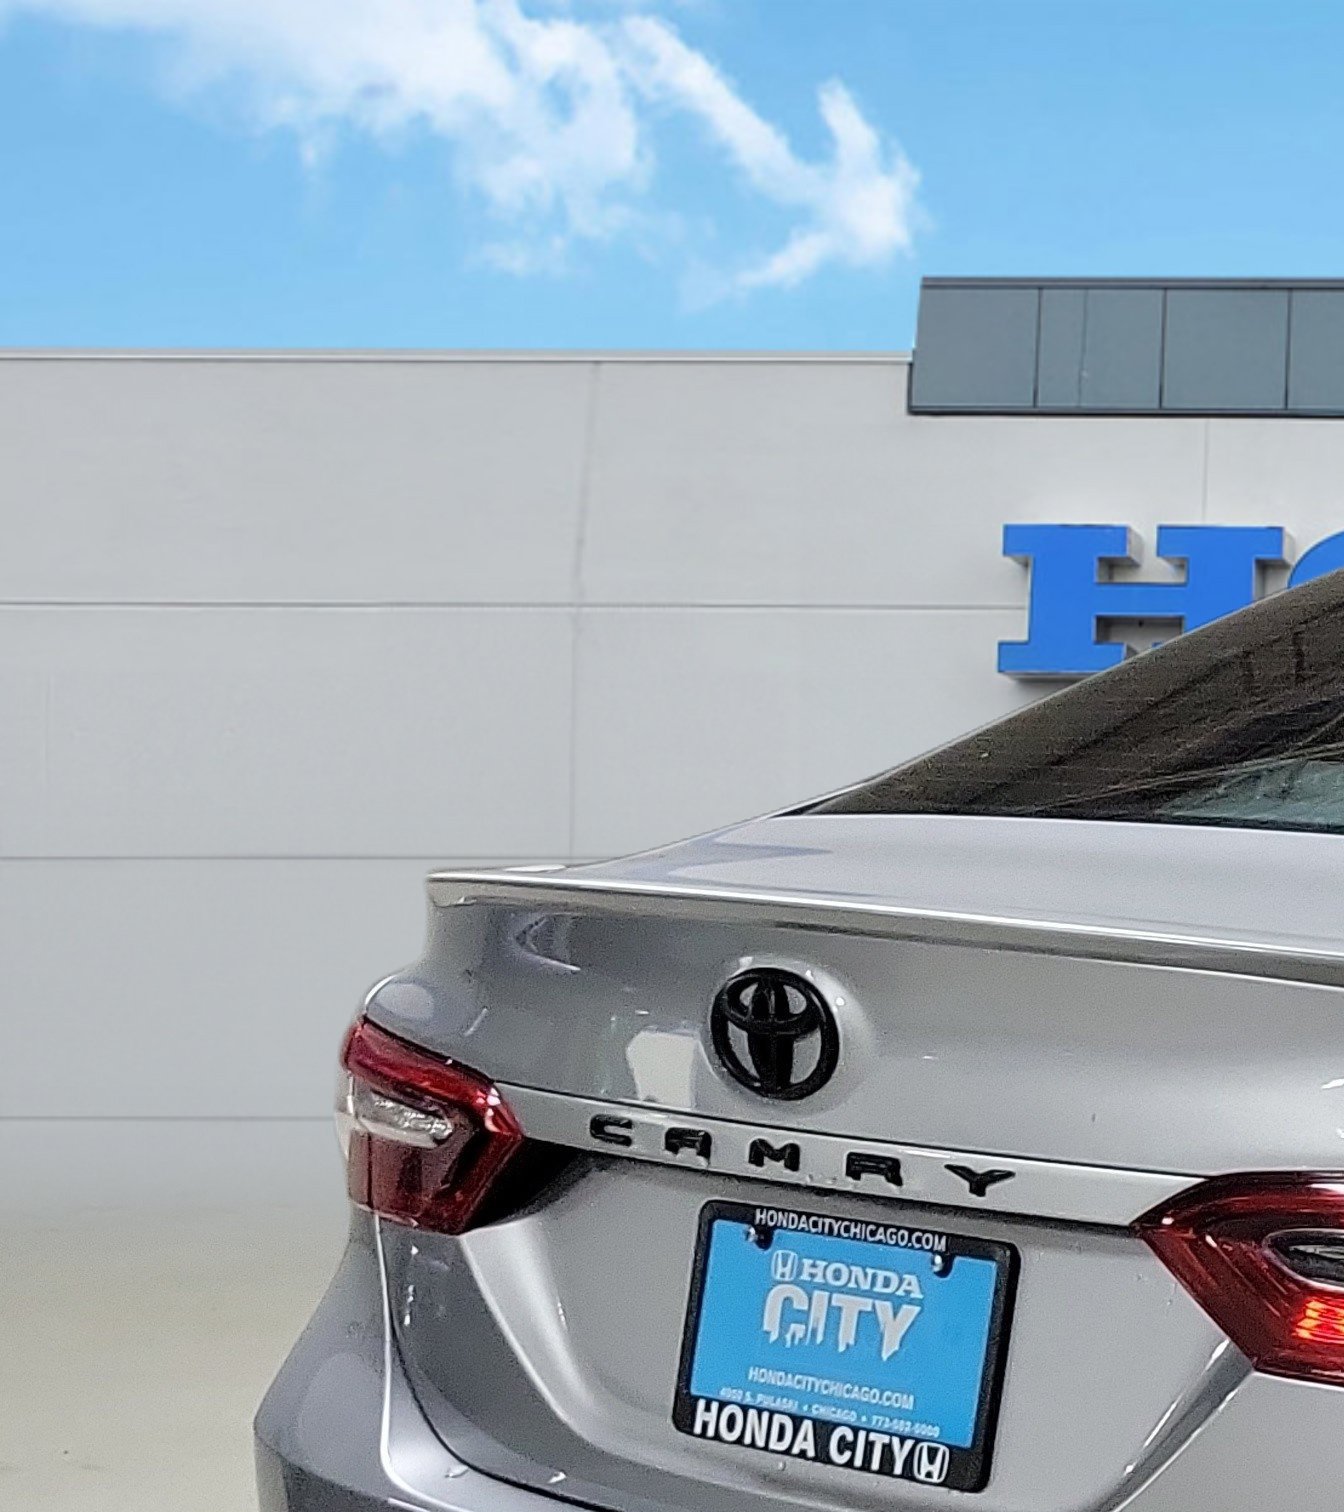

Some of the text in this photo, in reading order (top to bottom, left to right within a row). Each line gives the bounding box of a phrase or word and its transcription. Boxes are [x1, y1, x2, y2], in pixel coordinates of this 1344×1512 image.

[589, 1113, 1017, 1198] CAMRY
[754, 1208, 947, 1252] HONDACITYCHICAGO.COM
[800, 1258, 924, 1300] HONDA
[763, 1283, 922, 1362] CITY
[748, 1366, 915, 1411] HONDACITYCHICAGO.COM
[693, 1398, 916, 1476] HONDA CITY
